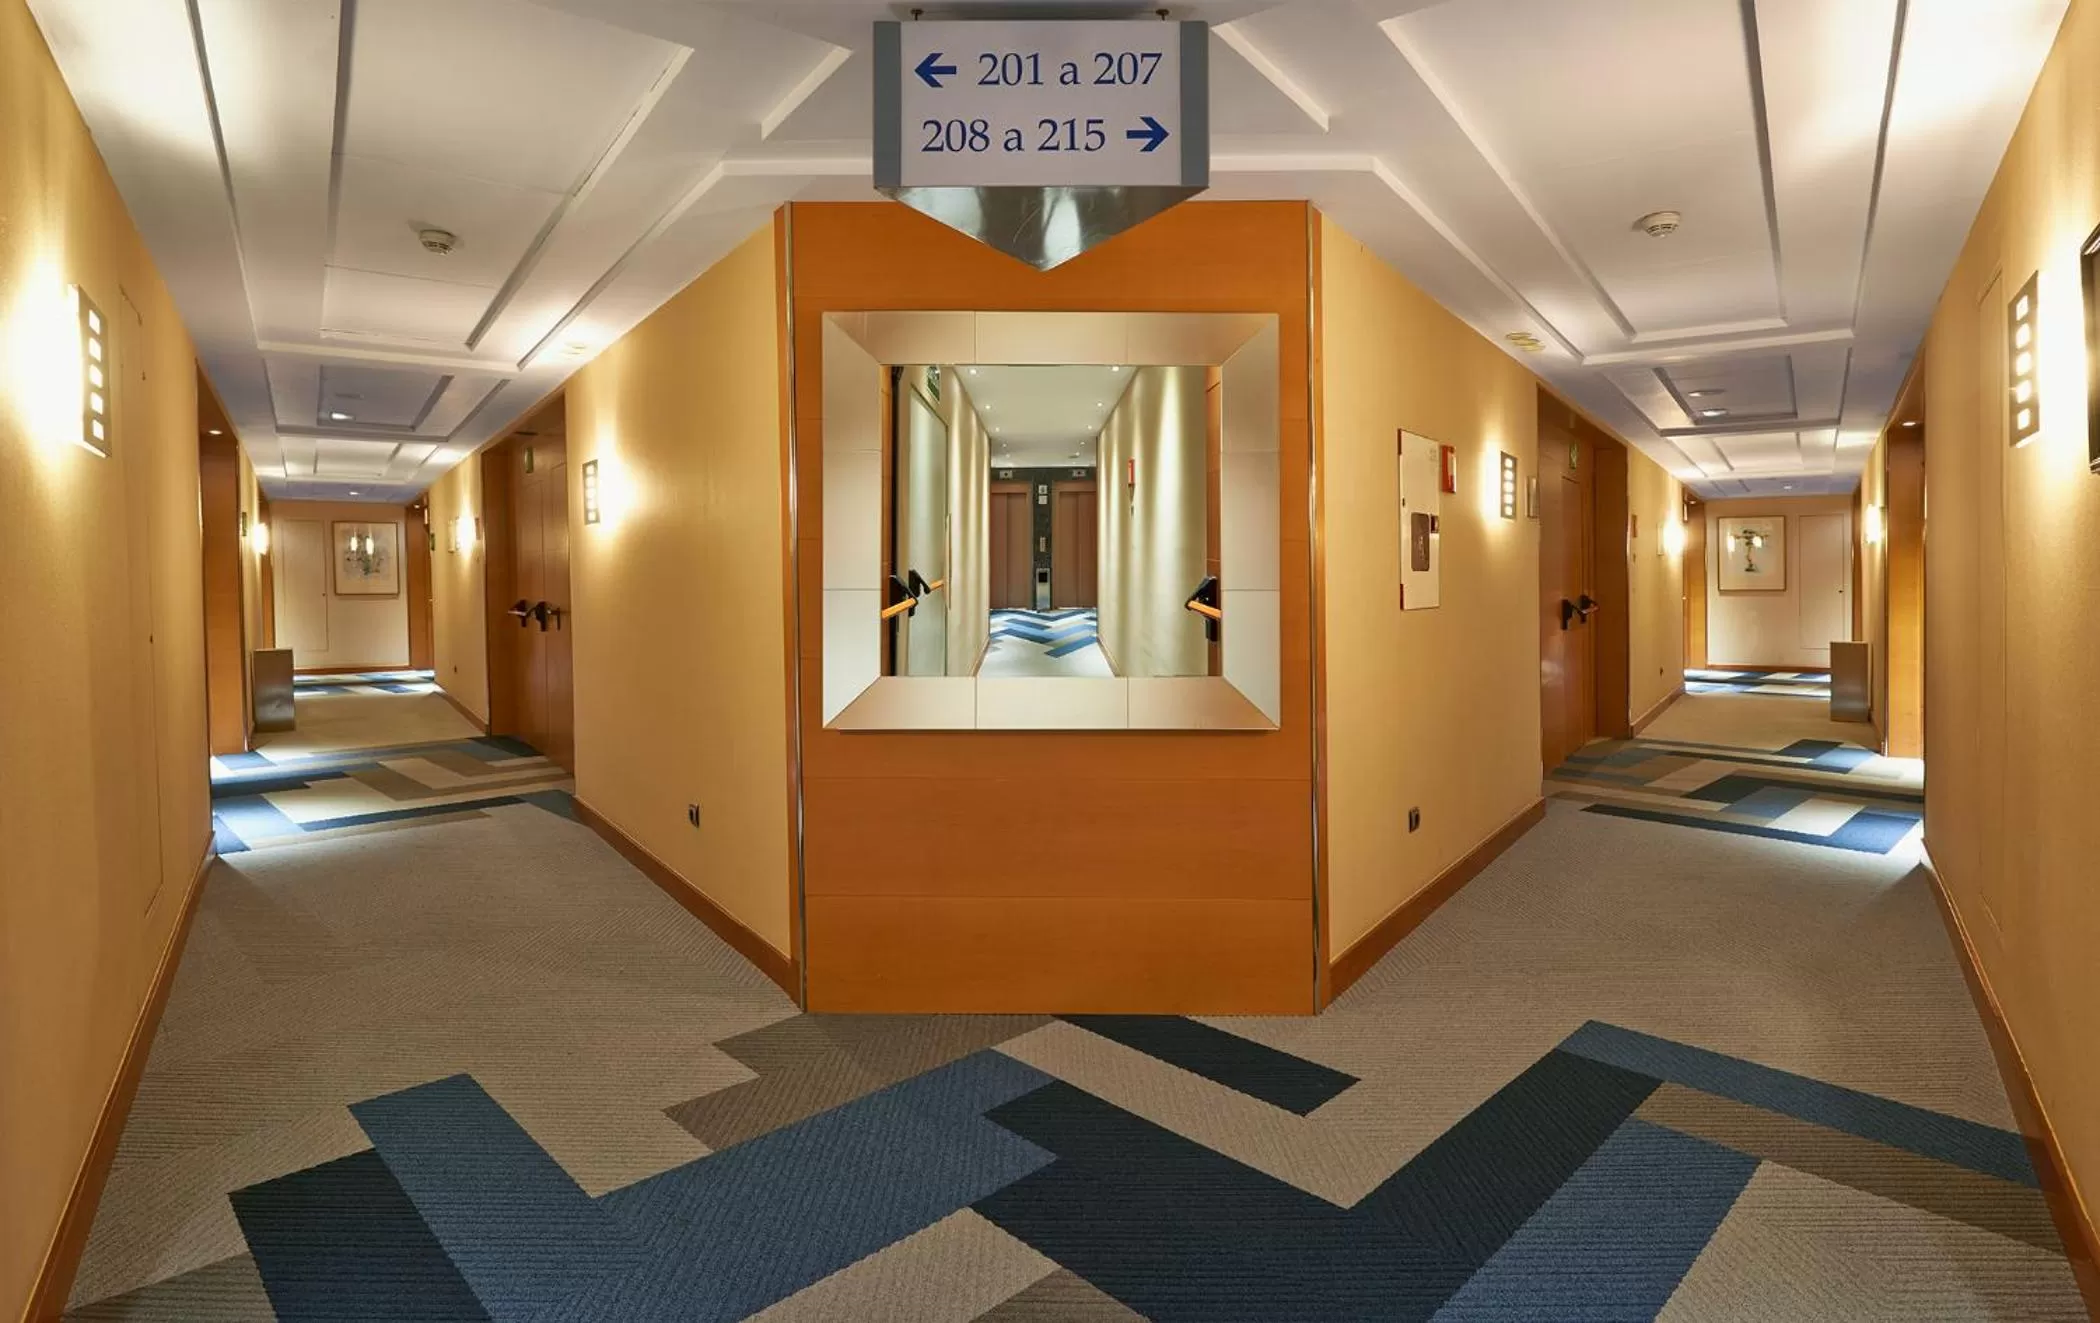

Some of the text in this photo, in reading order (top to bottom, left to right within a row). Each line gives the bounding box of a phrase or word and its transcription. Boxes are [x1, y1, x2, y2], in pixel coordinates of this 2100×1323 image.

[977, 52, 1163, 86] 201 a 207
[921, 118, 1106, 152] 208 a 215
